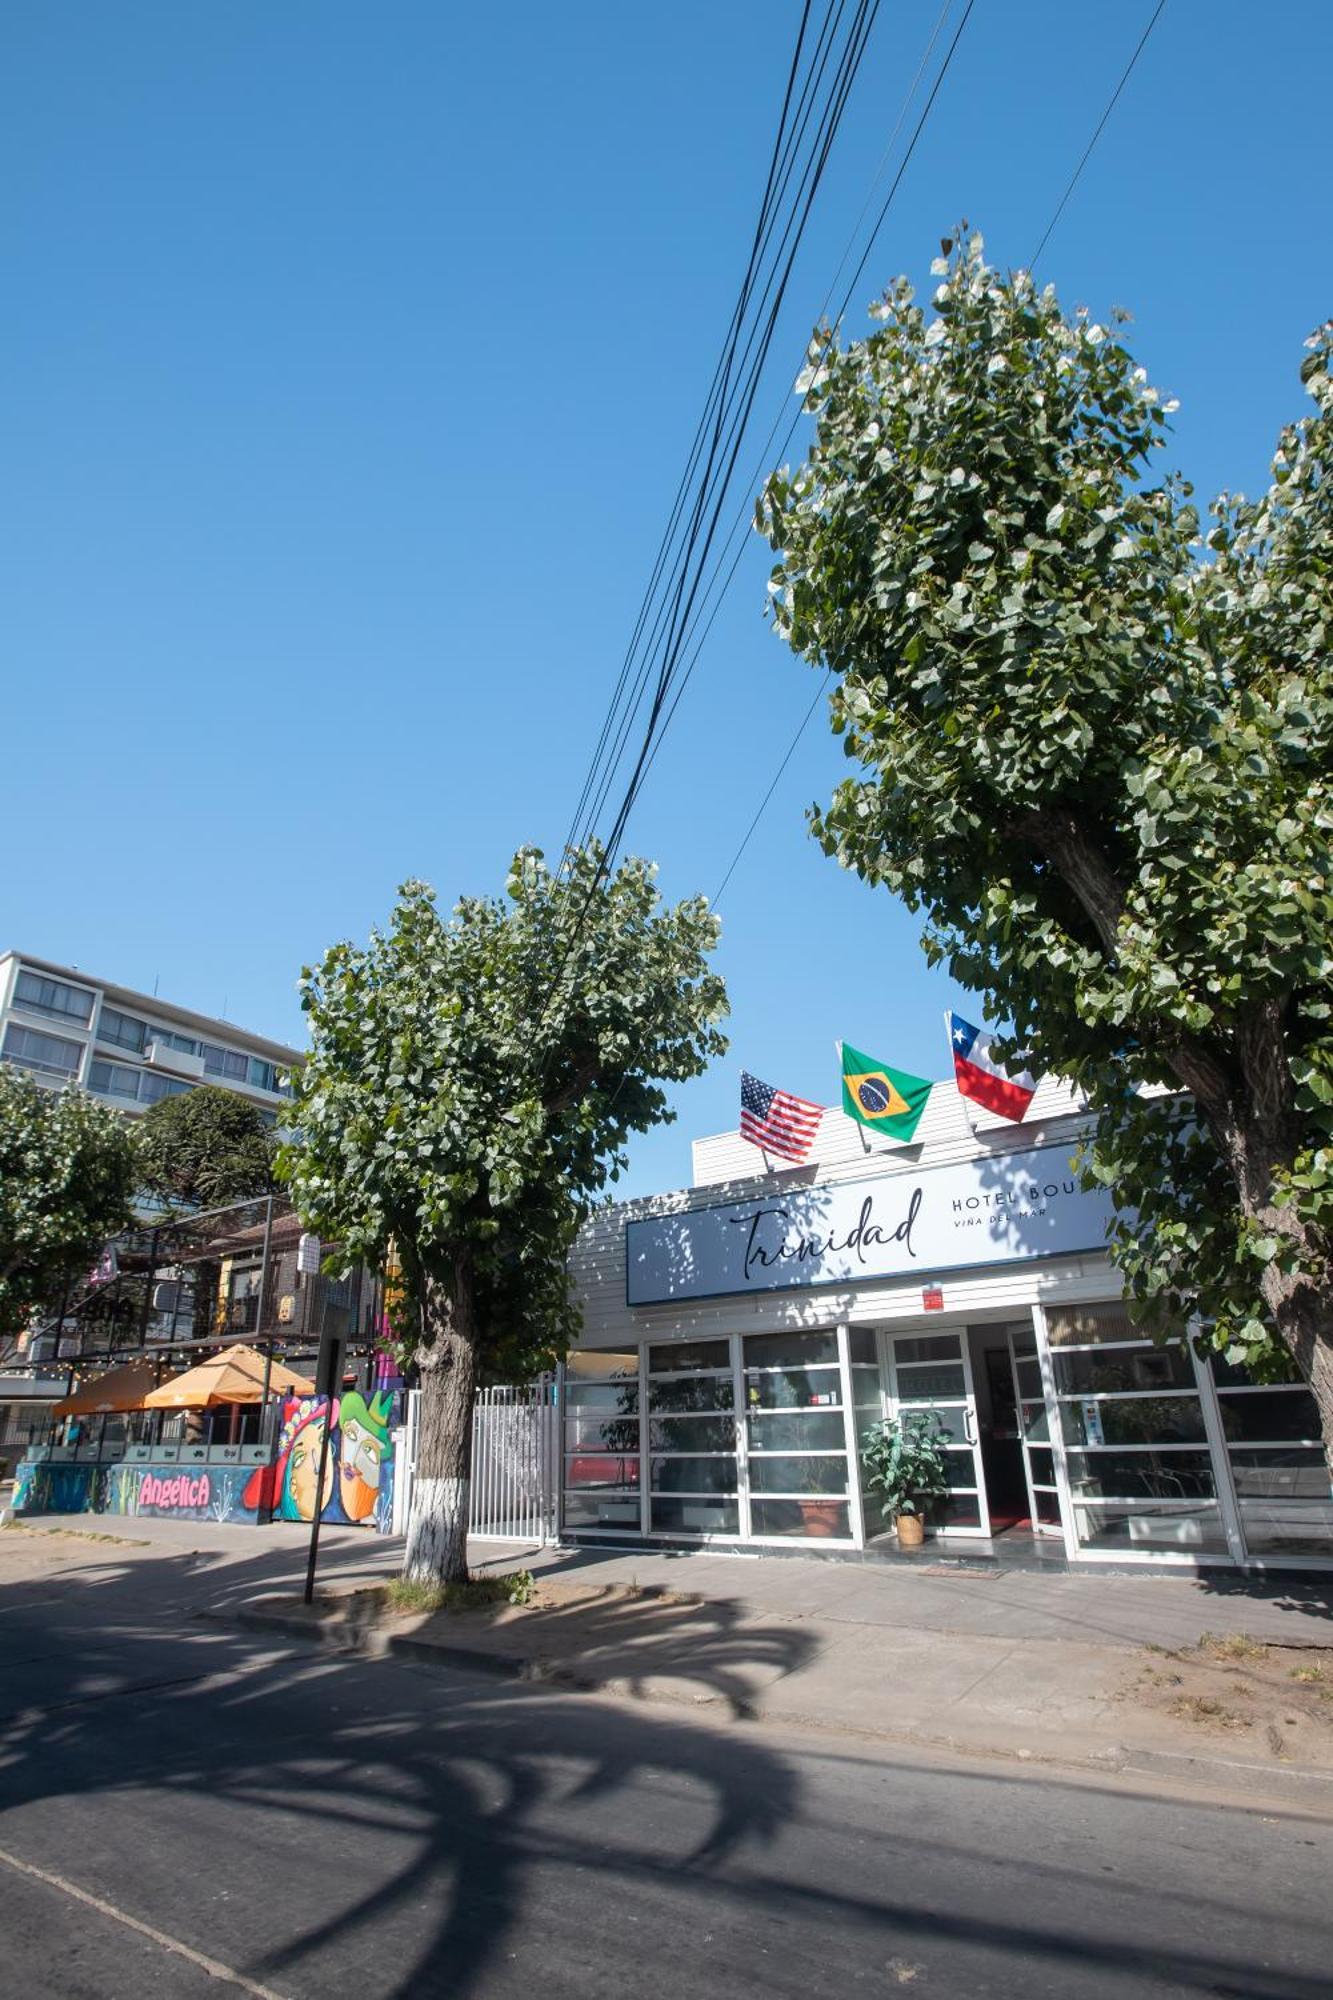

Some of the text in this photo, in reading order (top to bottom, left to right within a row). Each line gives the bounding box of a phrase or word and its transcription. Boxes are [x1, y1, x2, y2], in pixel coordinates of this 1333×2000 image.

[952, 1181, 1076, 1211] HOTEL BOU
[990, 1213, 1011, 1224] DEL
[1019, 1208, 1047, 1218] MAR
[729, 1187, 922, 1280] Trinidad
